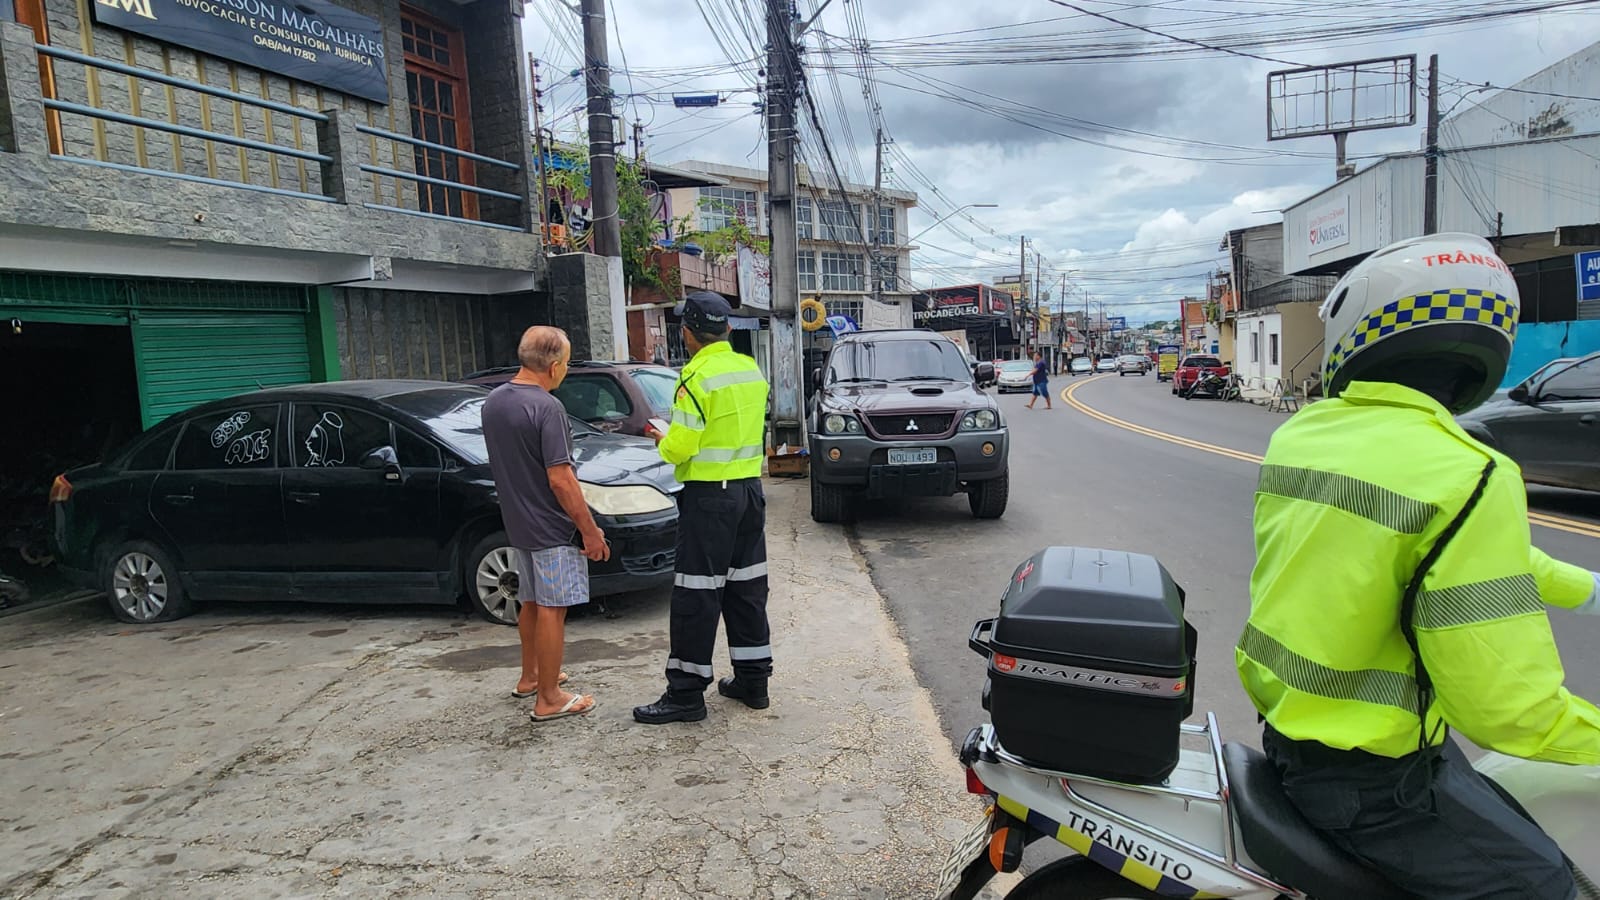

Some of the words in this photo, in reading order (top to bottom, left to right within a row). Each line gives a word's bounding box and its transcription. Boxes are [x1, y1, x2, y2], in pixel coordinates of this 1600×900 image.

[250, 18, 257, 29] E
[259, 21, 331, 53] CONSULTORIA
[334, 46, 373, 67] JURÍDICA
[253, 34, 292, 56] OAB/AM
[281, 7, 384, 58] MAGALHÃES
[1423, 250, 1515, 281] TRÂNSIT
[1018, 664, 1139, 688] TRAFFIC
[1069, 811, 1193, 881] TRÂNSITO
